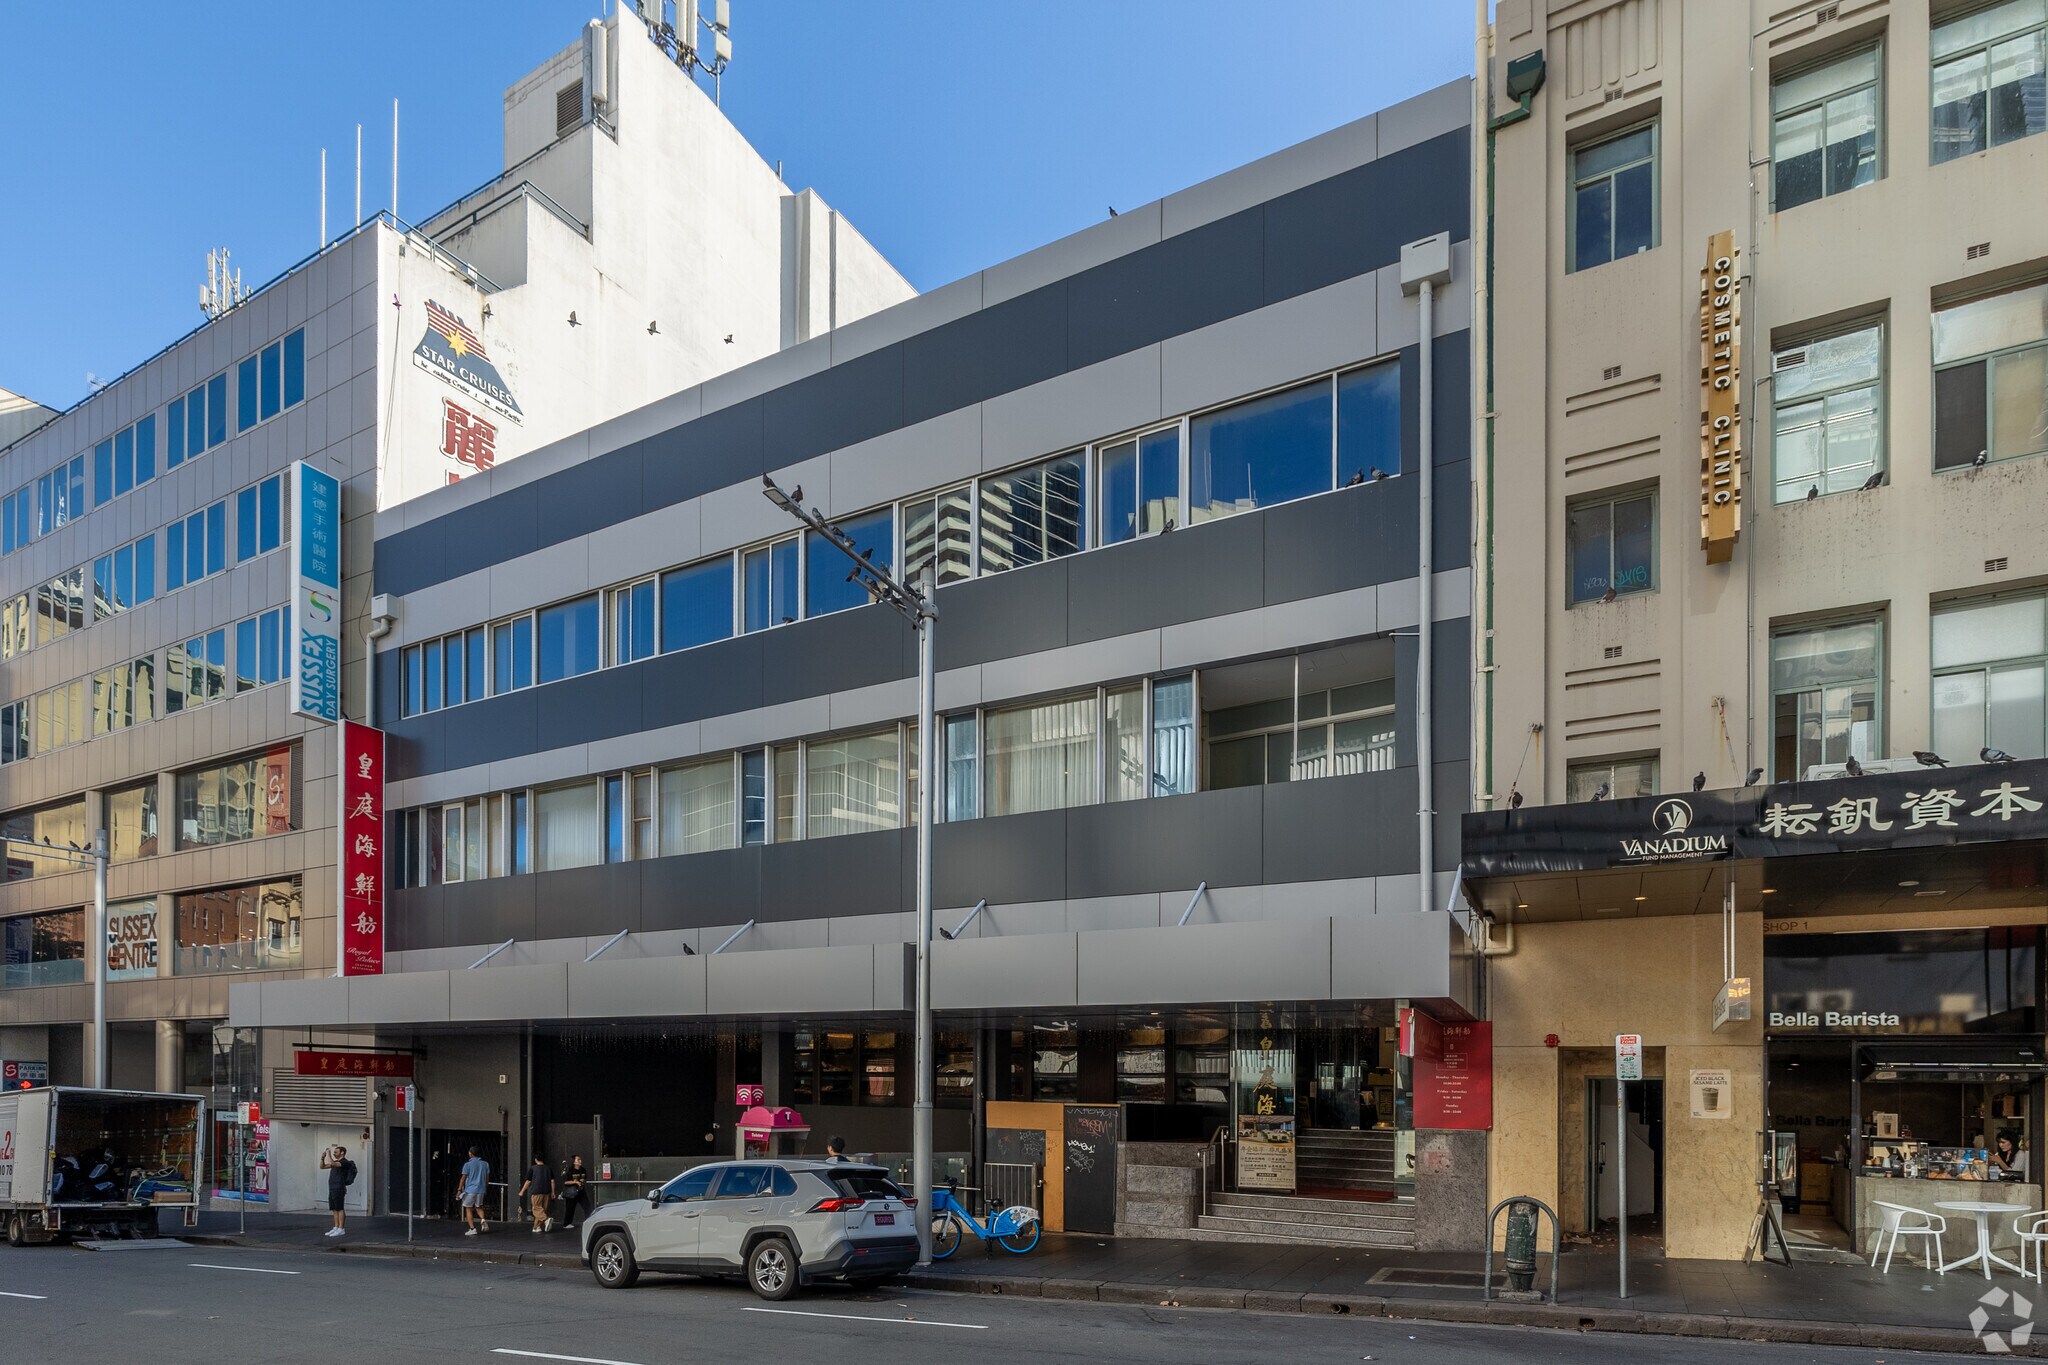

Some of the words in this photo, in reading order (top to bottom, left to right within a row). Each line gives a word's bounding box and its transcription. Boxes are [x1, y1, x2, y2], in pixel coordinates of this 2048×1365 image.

[1714, 256, 1731, 391] COSMETIC
[421, 345, 455, 374] STAR
[459, 367, 513, 406] CRUISES
[442, 399, 498, 484] 麗
[1714, 415, 1731, 506] CLINIC
[301, 627, 324, 717] SUSSEX
[325, 638, 337, 691] SURGERY
[325, 692, 337, 717] DAY
[1619, 834, 1728, 856] VANADIUM
[1660, 851, 1703, 860] MANAGEMENT
[109, 912, 158, 943] SUSSEX
[1763, 921, 1798, 932] SHOP
[1802, 921, 1808, 930] 1
[108, 941, 158, 971] CENTRE
[1769, 1012, 1819, 1026] Bella
[1825, 1011, 1900, 1026] Barista
